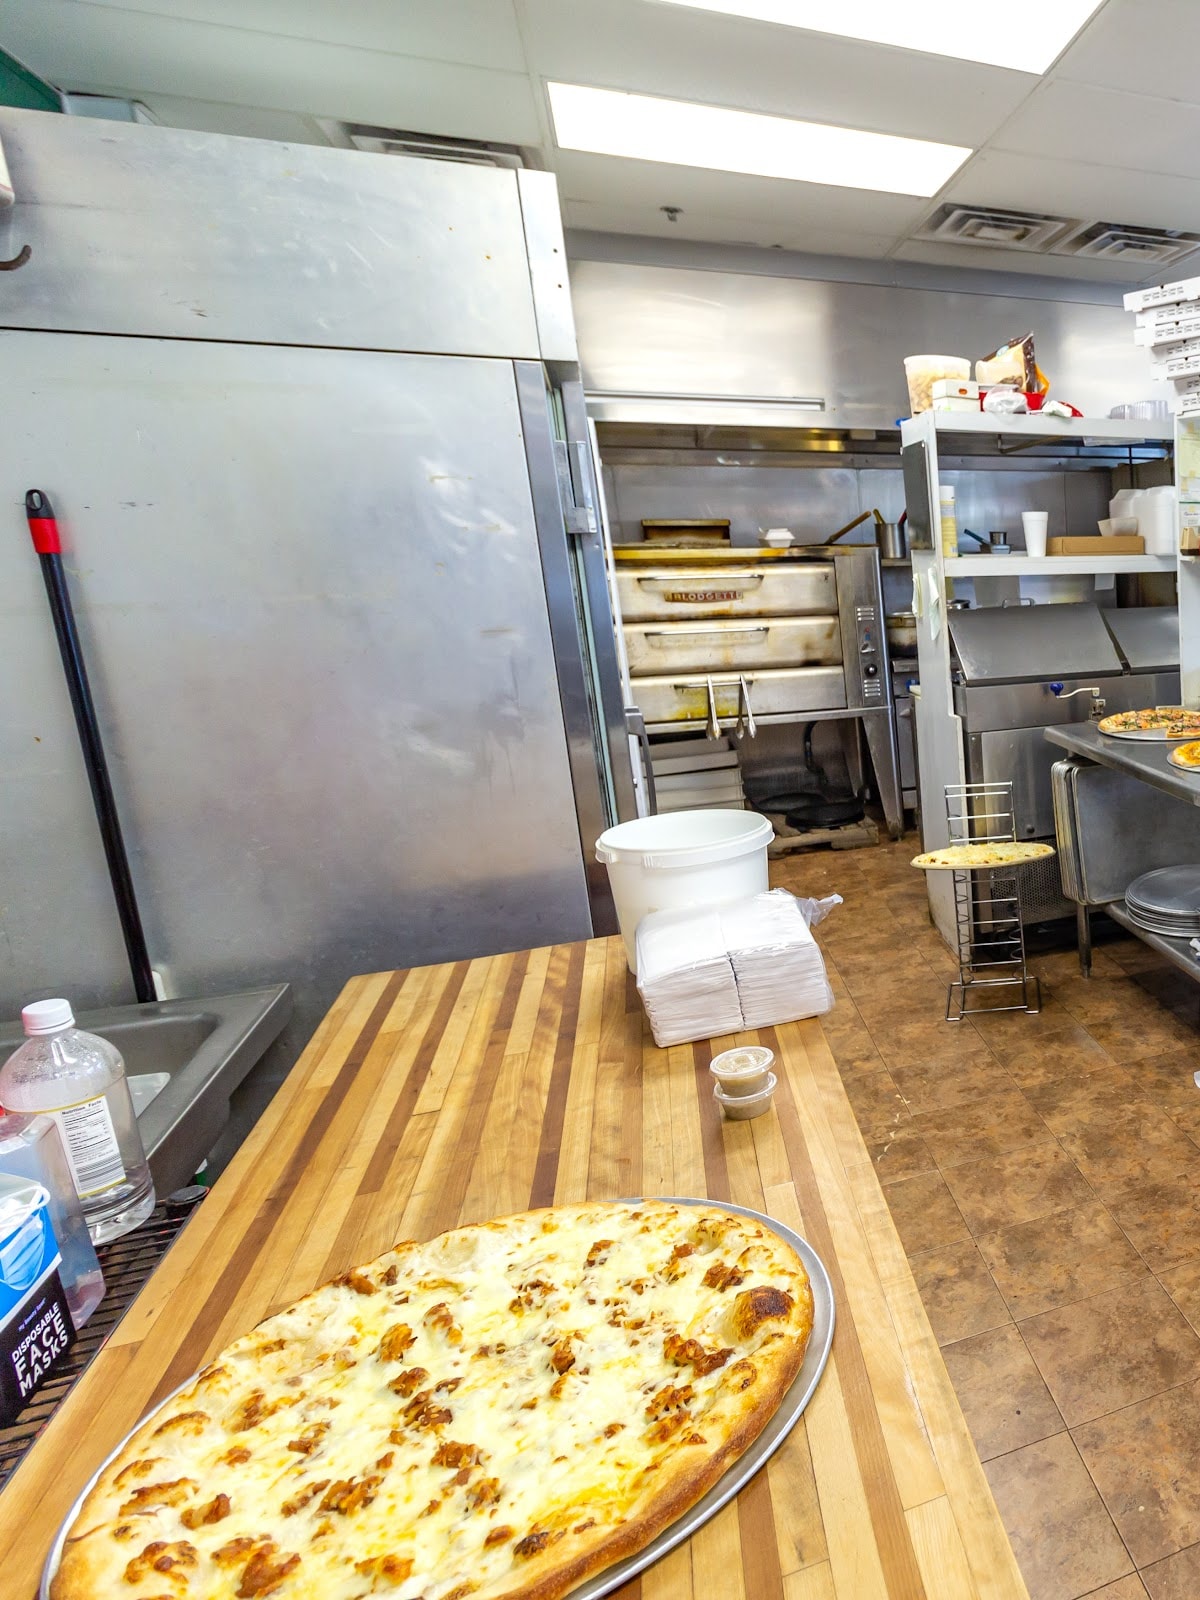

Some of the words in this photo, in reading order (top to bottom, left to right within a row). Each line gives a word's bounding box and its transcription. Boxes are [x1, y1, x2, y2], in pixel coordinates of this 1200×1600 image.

[674, 591, 736, 601] BLODGETT
[62, 1106, 86, 1115] Nutrition
[12, 1302, 60, 1363] DISPOSABLE
[15, 1312, 62, 1381] FACE
[19, 1329, 68, 1397] MASKS
